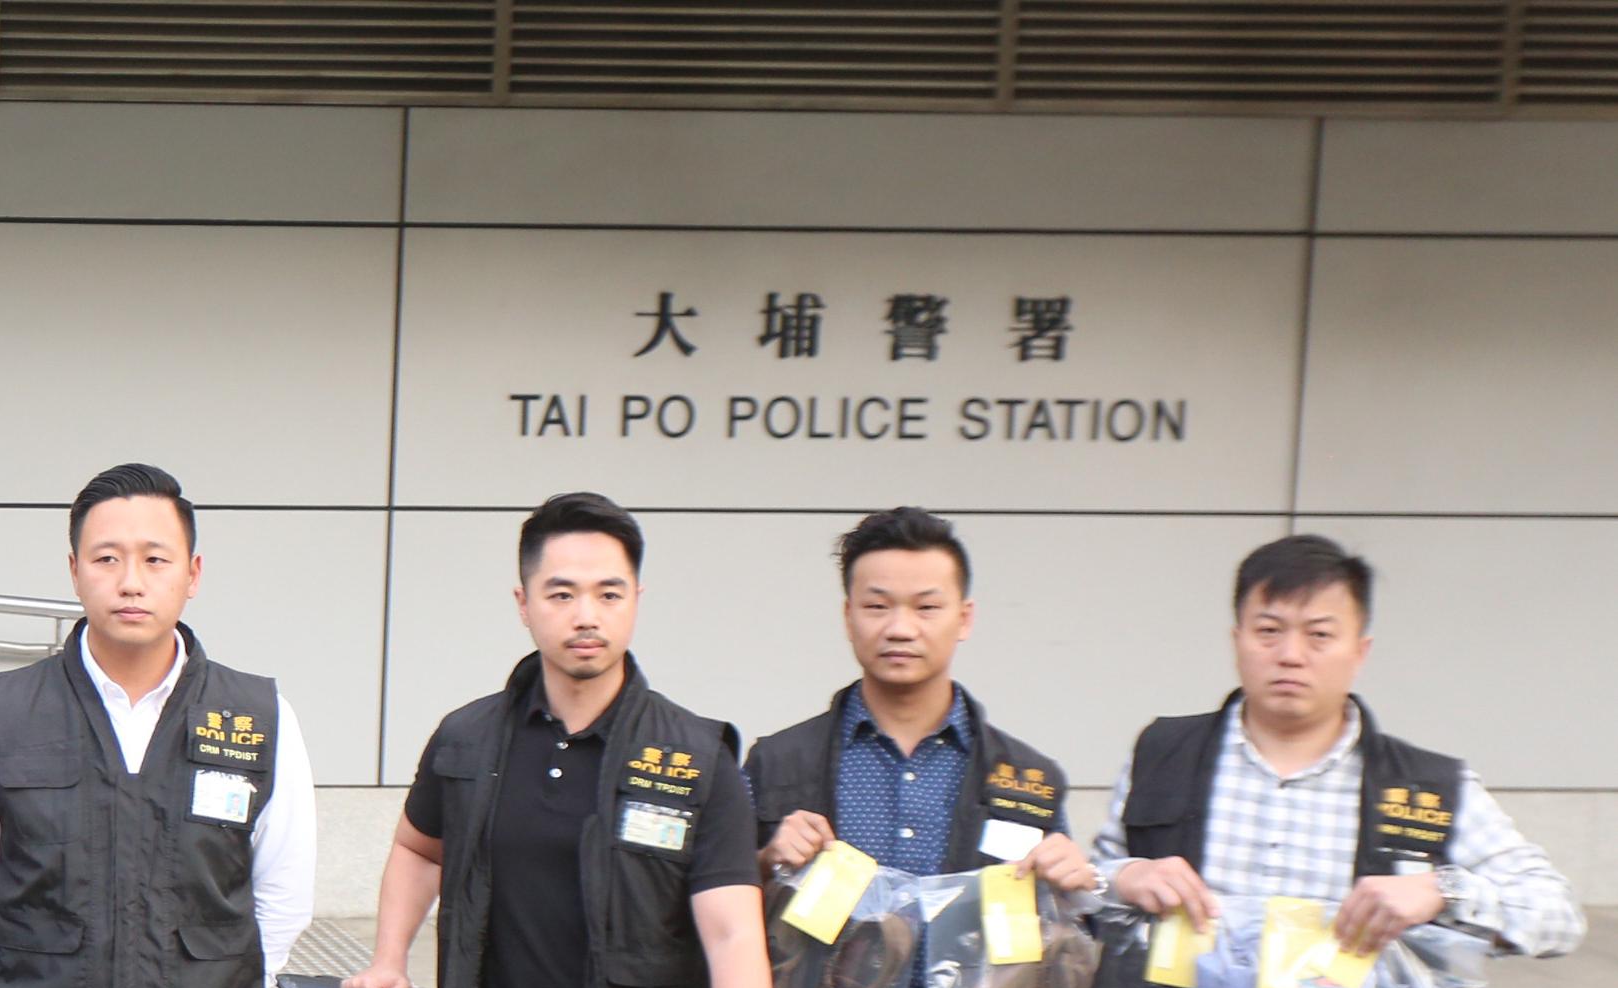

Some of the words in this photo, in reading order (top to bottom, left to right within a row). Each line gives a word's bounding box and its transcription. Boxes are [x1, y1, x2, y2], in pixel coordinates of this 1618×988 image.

[632, 292, 1074, 362] 大埔警署
[509, 394, 588, 437] TAI
[620, 394, 696, 438] PO
[727, 395, 930, 440] POLICE
[958, 398, 1188, 443] STATION
[199, 744, 220, 755] CRM
[223, 748, 259, 761] TPDIST
[987, 773, 1055, 799] POLICE
[1376, 803, 1453, 827] POLICE
